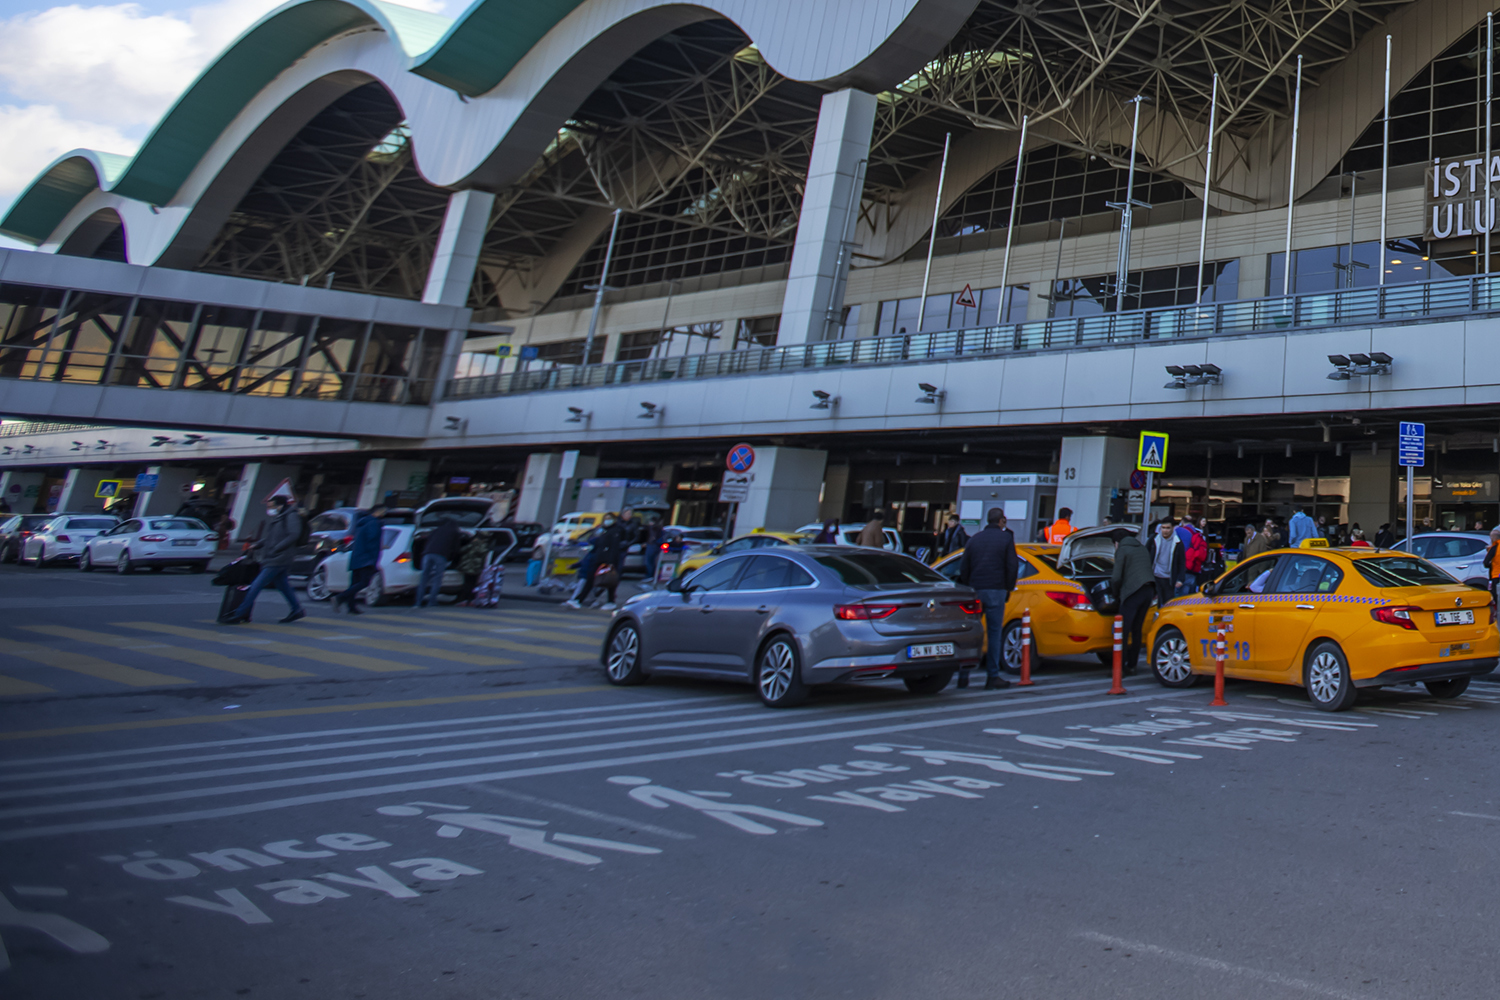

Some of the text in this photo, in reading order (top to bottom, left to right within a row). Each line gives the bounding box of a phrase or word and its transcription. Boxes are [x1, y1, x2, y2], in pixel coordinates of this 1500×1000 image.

[1064, 467, 1076, 480] 13
[1438, 612, 1447, 623] 34
[1234, 640, 1250, 661] 18
[1064, 717, 1212, 737] önce
[1162, 727, 1302, 751] yaya
[715, 759, 911, 788] önce
[806, 775, 1005, 813] yaya
[100, 832, 393, 880] önce
[164, 857, 486, 925] yaya
